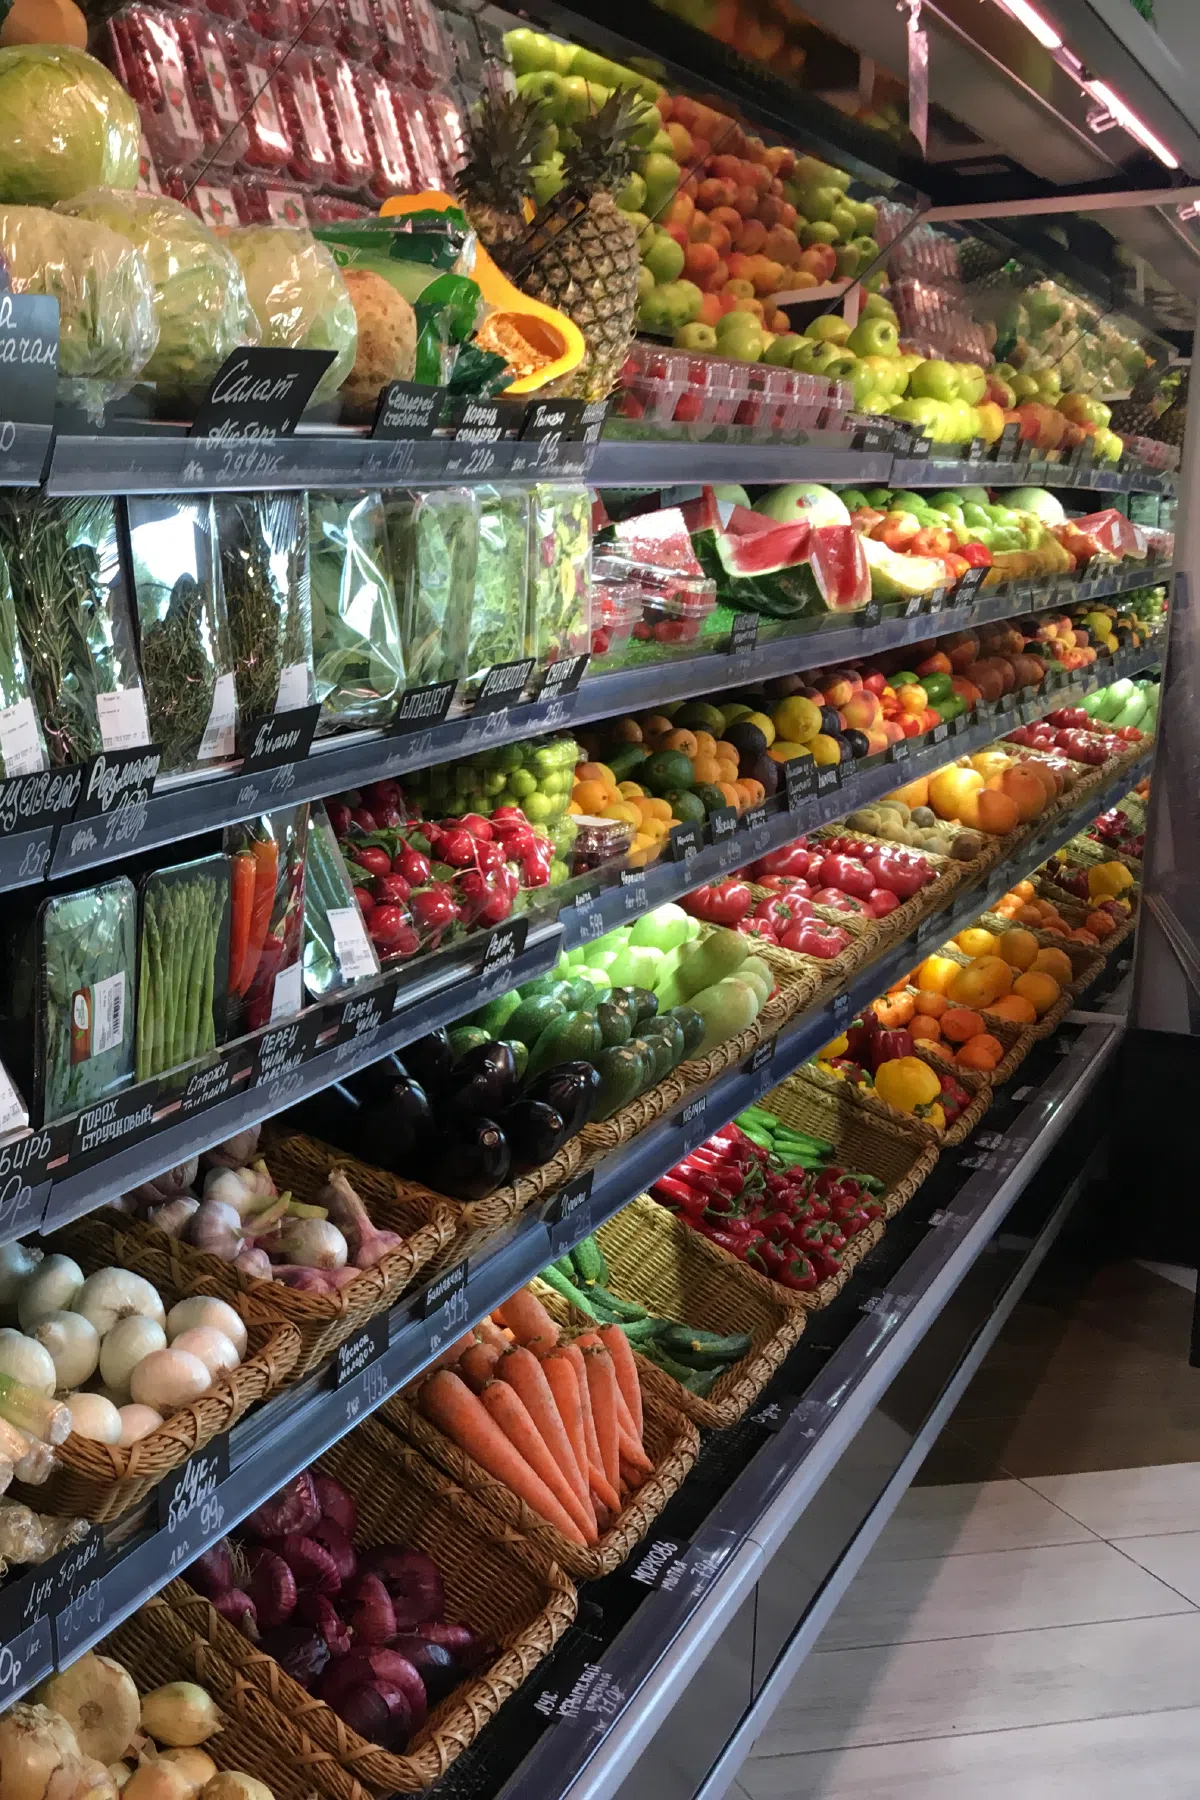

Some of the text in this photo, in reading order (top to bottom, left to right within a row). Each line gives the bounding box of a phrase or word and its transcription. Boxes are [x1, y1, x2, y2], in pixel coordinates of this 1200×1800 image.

[212, 359, 301, 404] Салат
[258, 1025, 300, 1057] ПЕРЕЦ
[77, 1099, 119, 1136] ГОРОХ
[631, 1540, 679, 1586] МОРКОВЬ
